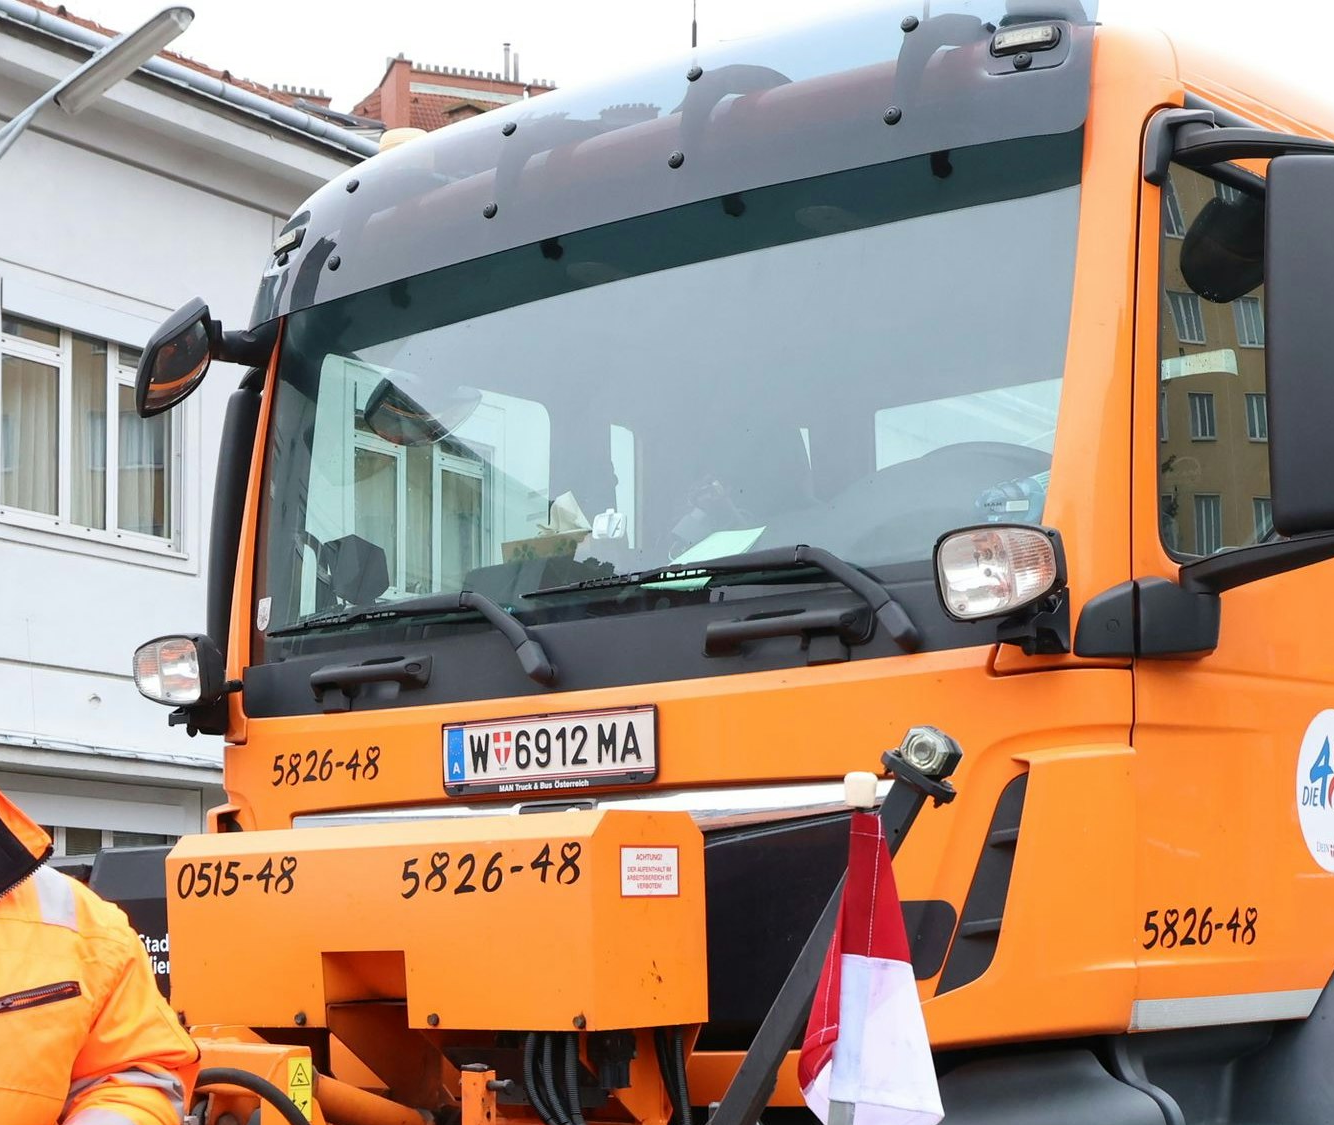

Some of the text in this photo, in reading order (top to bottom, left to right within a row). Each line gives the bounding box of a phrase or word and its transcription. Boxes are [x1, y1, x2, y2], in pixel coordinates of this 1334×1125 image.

[271, 746, 381, 788] 5826-48
[469, 720, 643, 774] W 6912 MA
[499, 778, 590, 792] MAN Truck & Bus Österreich
[1302, 786, 1319, 807] DIE
[177, 856, 297, 899] 0515-48
[401, 841, 582, 899] 5826-48
[1142, 907, 1258, 950] 5826-48
